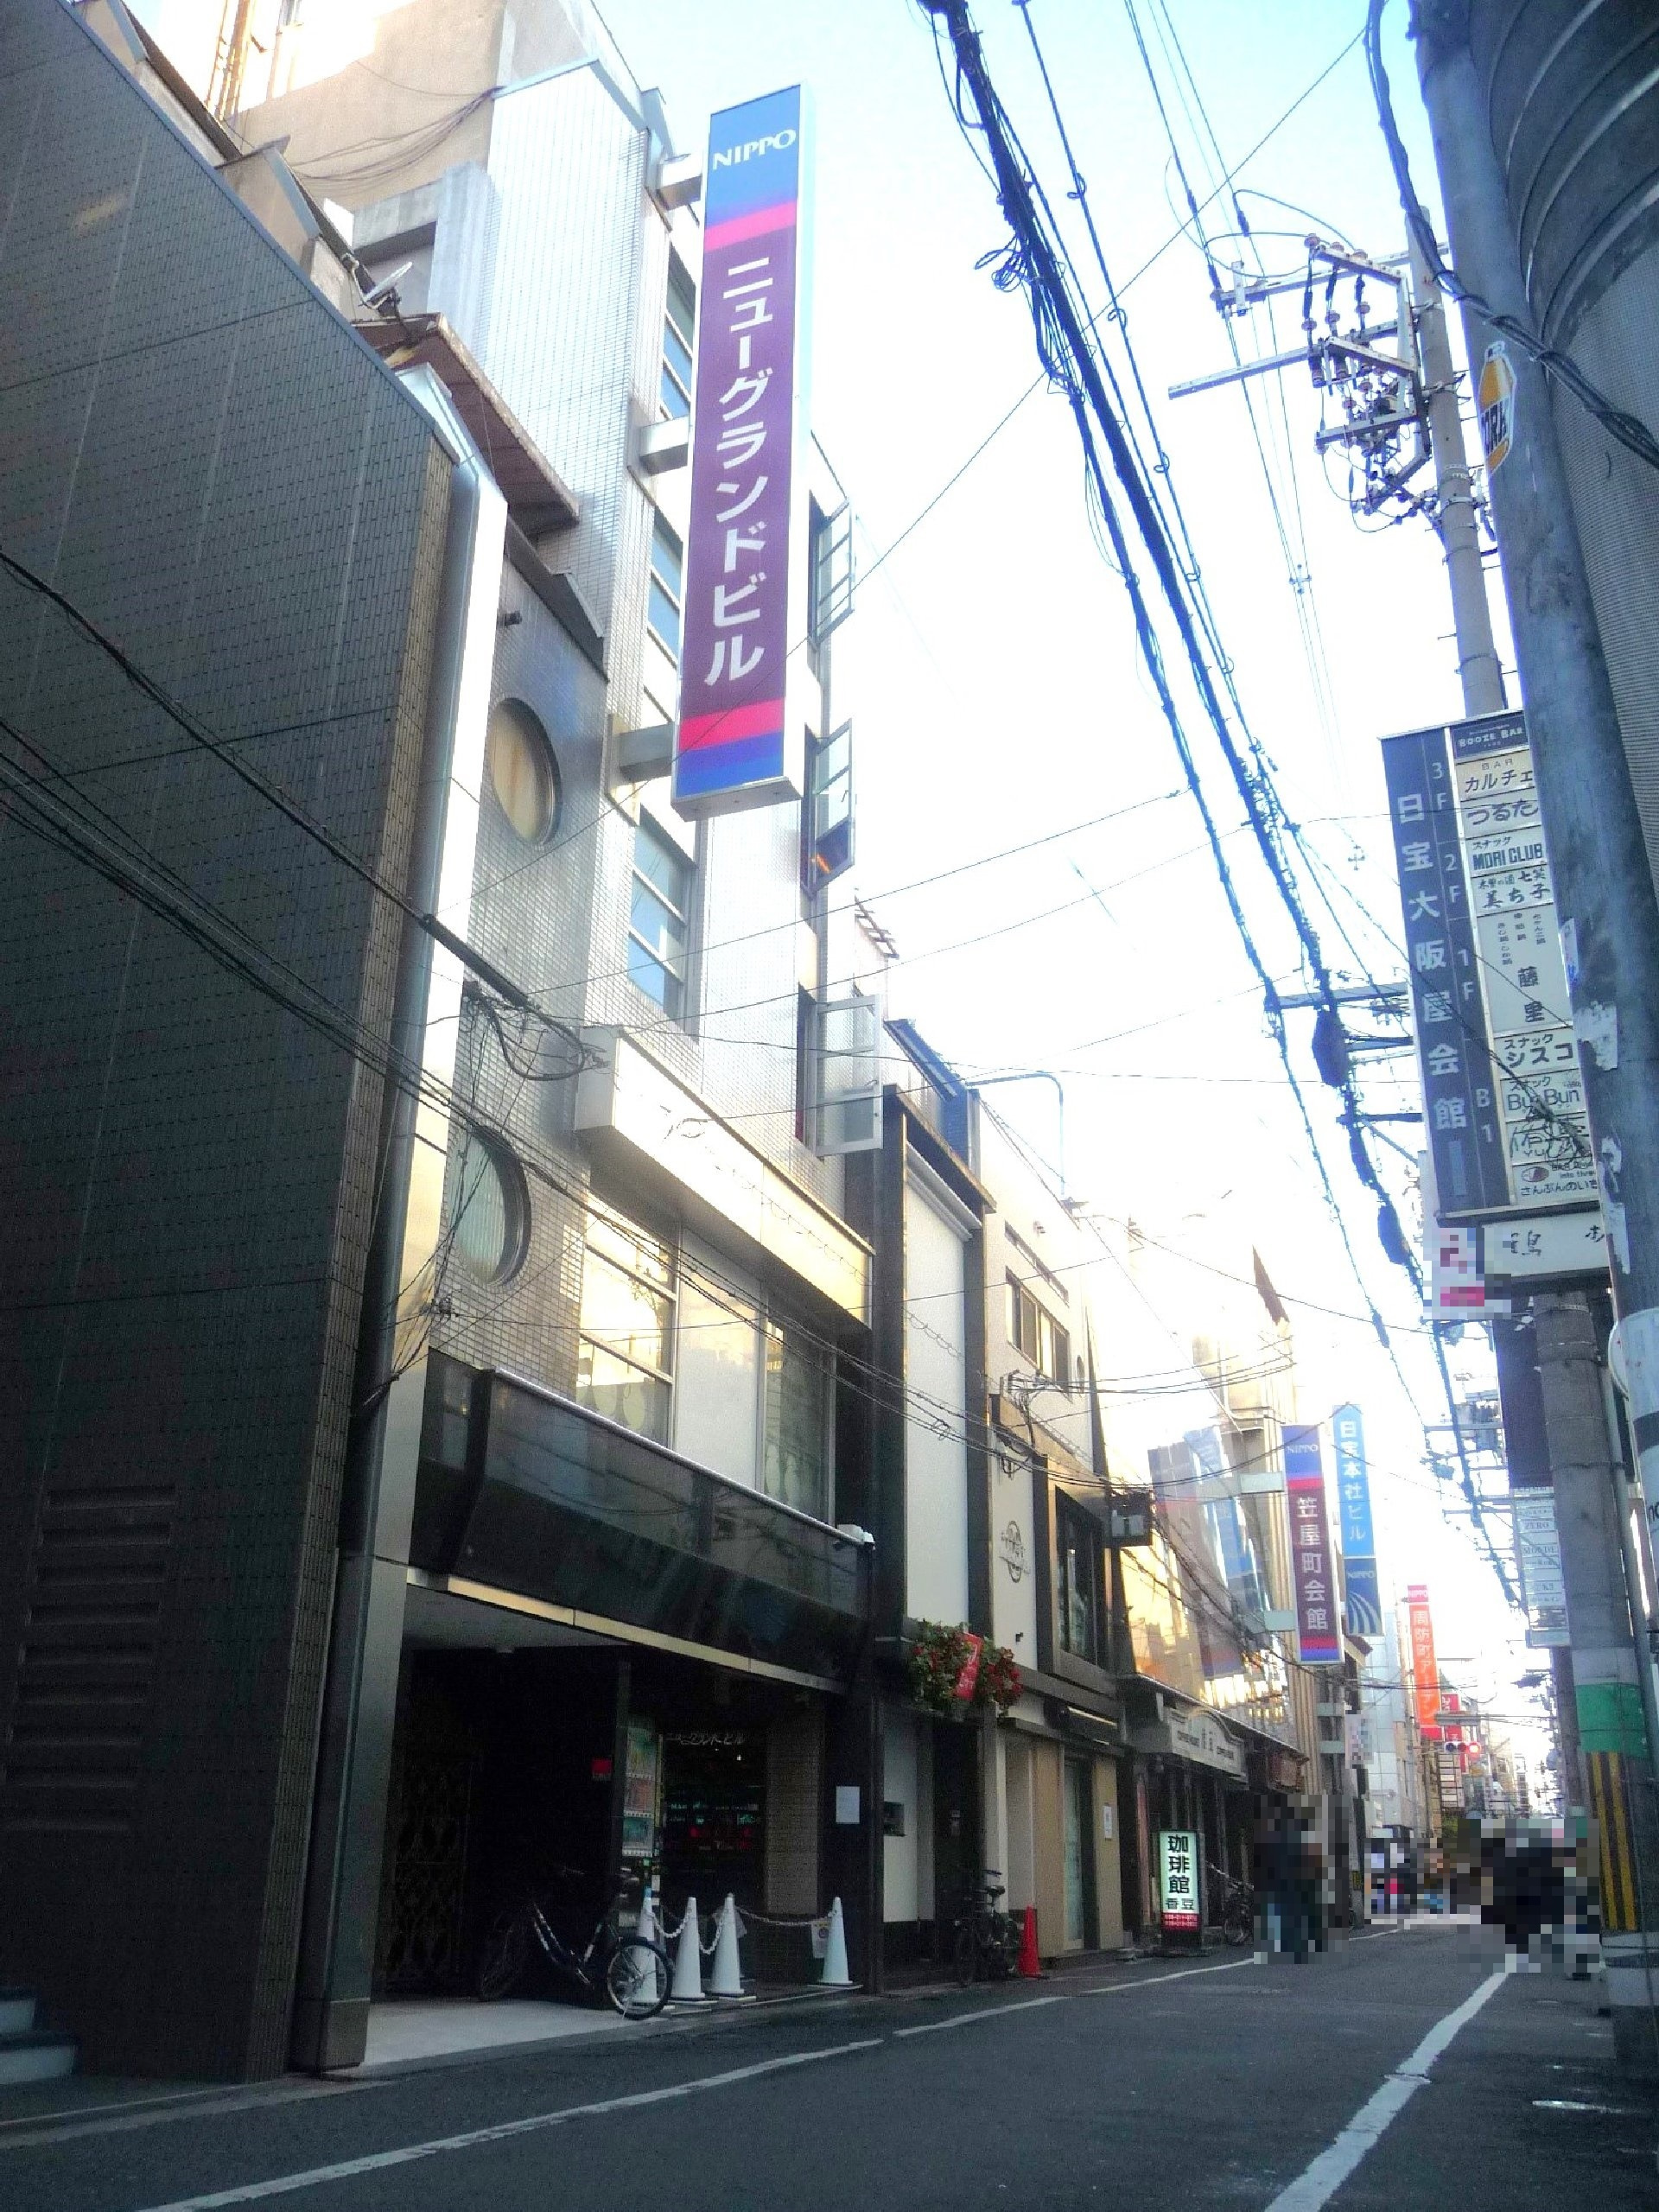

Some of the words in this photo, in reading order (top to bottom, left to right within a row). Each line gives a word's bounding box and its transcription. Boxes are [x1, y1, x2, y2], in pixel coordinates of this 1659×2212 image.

[711, 127, 798, 173] NIPPO
[704, 255, 777, 689] ニューグランドビル
[1458, 733, 1497, 747] BOOZE
[1501, 728, 1522, 739] BAR
[1481, 758, 1513, 771] BAR
[1466, 798, 1539, 825] つるた
[1472, 836, 1512, 850] スナック
[1472, 849, 1507, 871] MORI
[1508, 843, 1543, 863] CLUB
[1396, 793, 1467, 1130] 日宝大阪屋会館
[1503, 1033, 1554, 1051] スナック
[1505, 1042, 1574, 1069] シスコ
[1507, 1093, 1541, 1112] Bu
[1543, 1088, 1580, 1106] Bun
[1287, 1444, 1319, 1454] NIPPO
[1339, 1421, 1367, 1541] 日宝本社ビル
[1297, 1496, 1329, 1631] 笠屋町会館
[1347, 1569, 1376, 1580] NIPPO
[1167, 1834, 1190, 1894] 珈琲館
